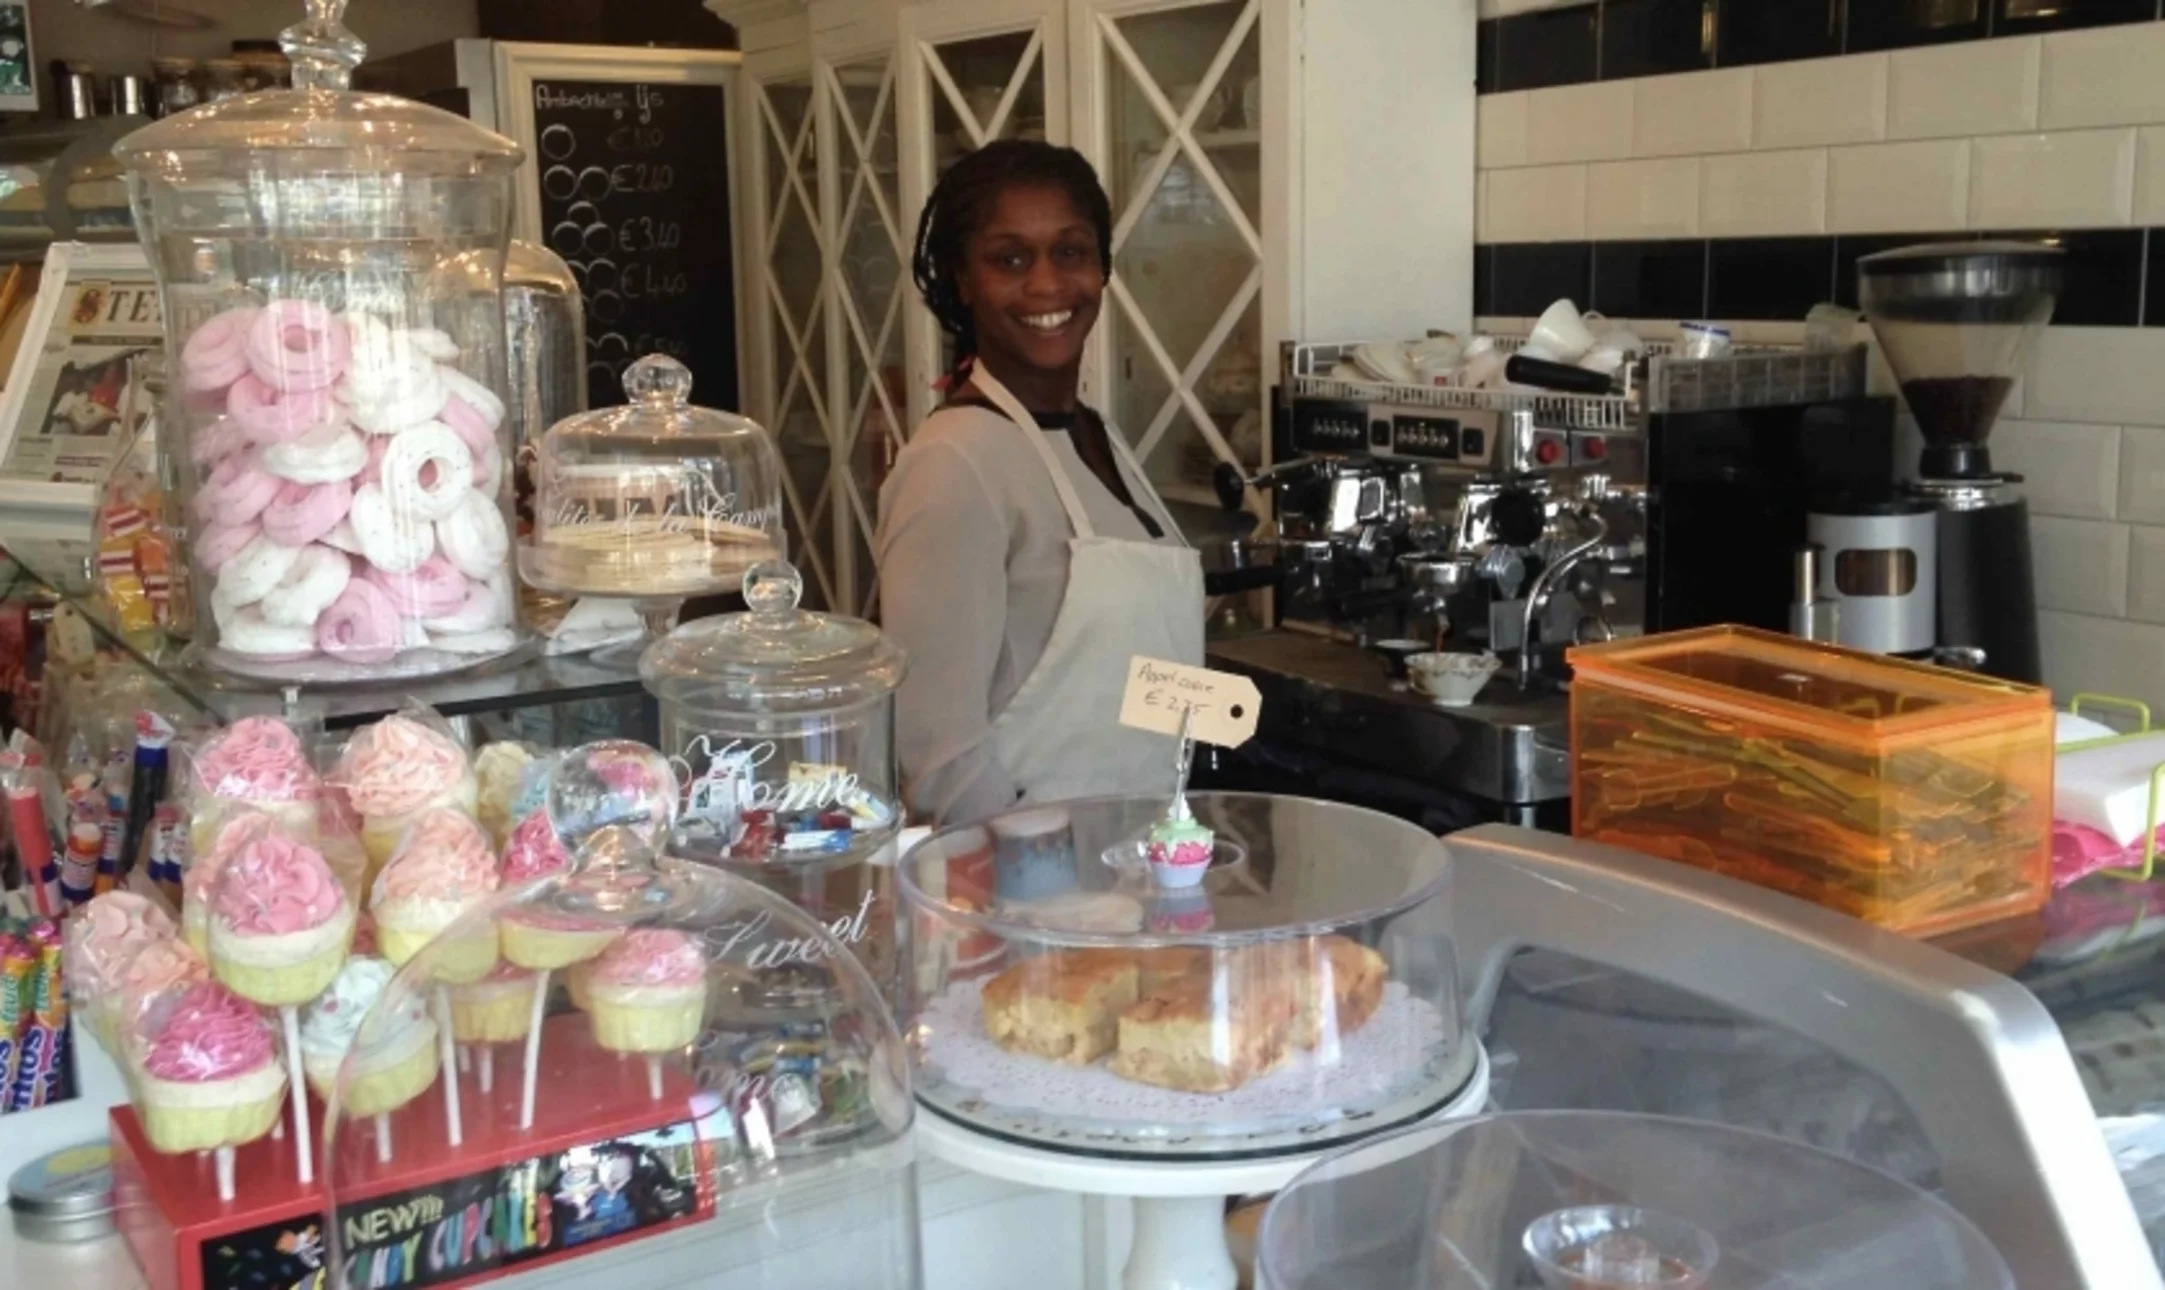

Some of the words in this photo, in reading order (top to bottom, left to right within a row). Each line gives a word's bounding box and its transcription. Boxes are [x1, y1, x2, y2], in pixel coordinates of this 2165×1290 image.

[670, 734, 862, 812] Home
[704, 888, 876, 967] Sweet
[429, 1190, 553, 1272] CUPCAKES
